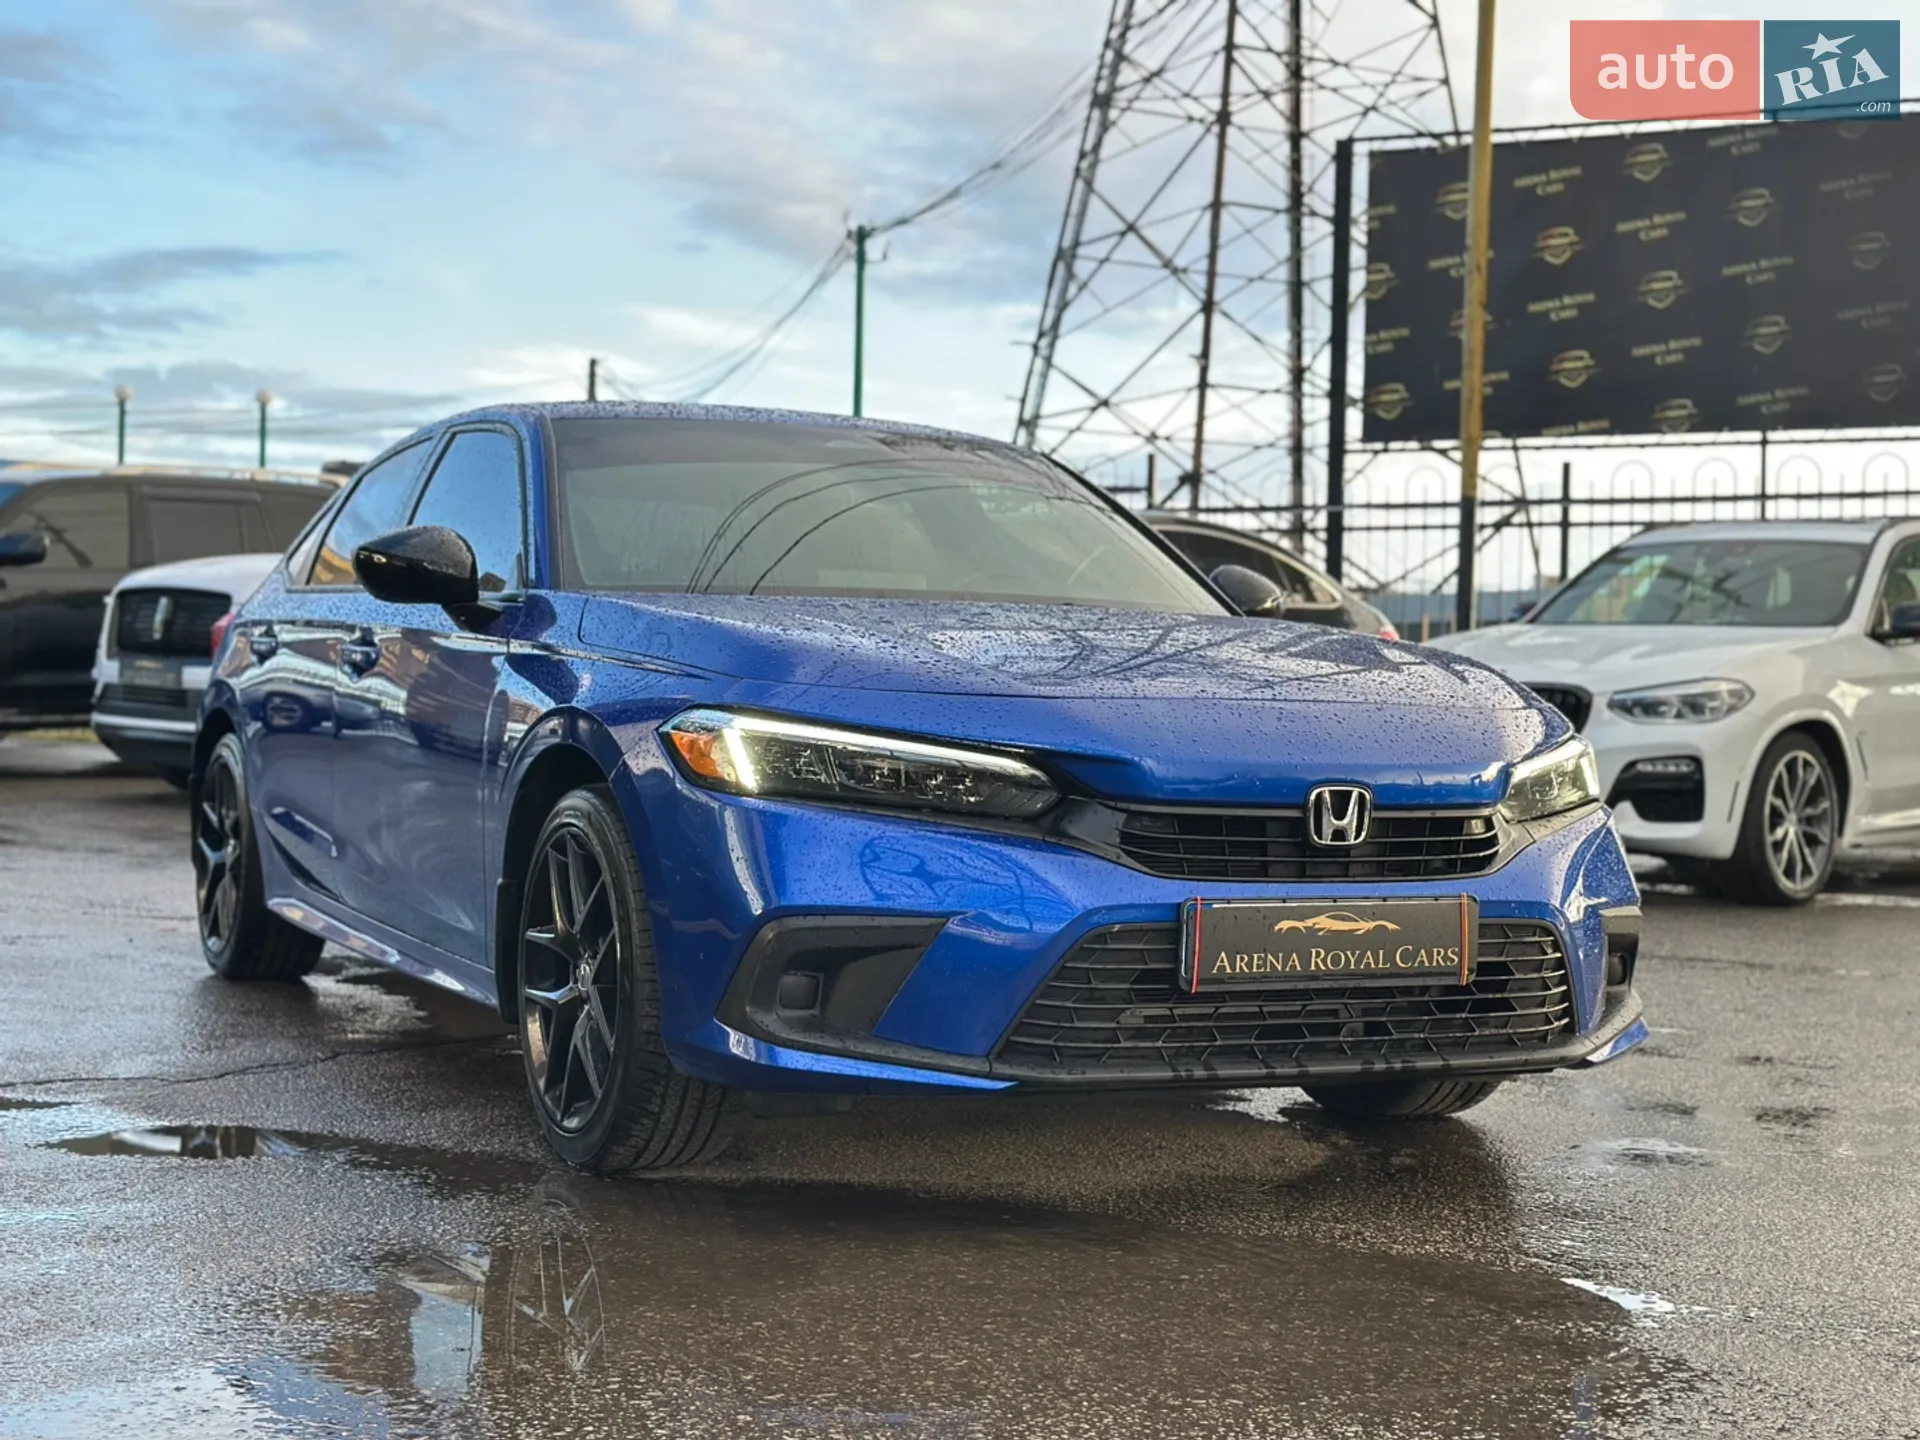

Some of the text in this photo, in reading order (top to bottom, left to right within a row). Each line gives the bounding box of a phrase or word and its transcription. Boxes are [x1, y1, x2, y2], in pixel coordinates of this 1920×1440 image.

[1211, 945, 1460, 974] ARENA ROYAL CARS
